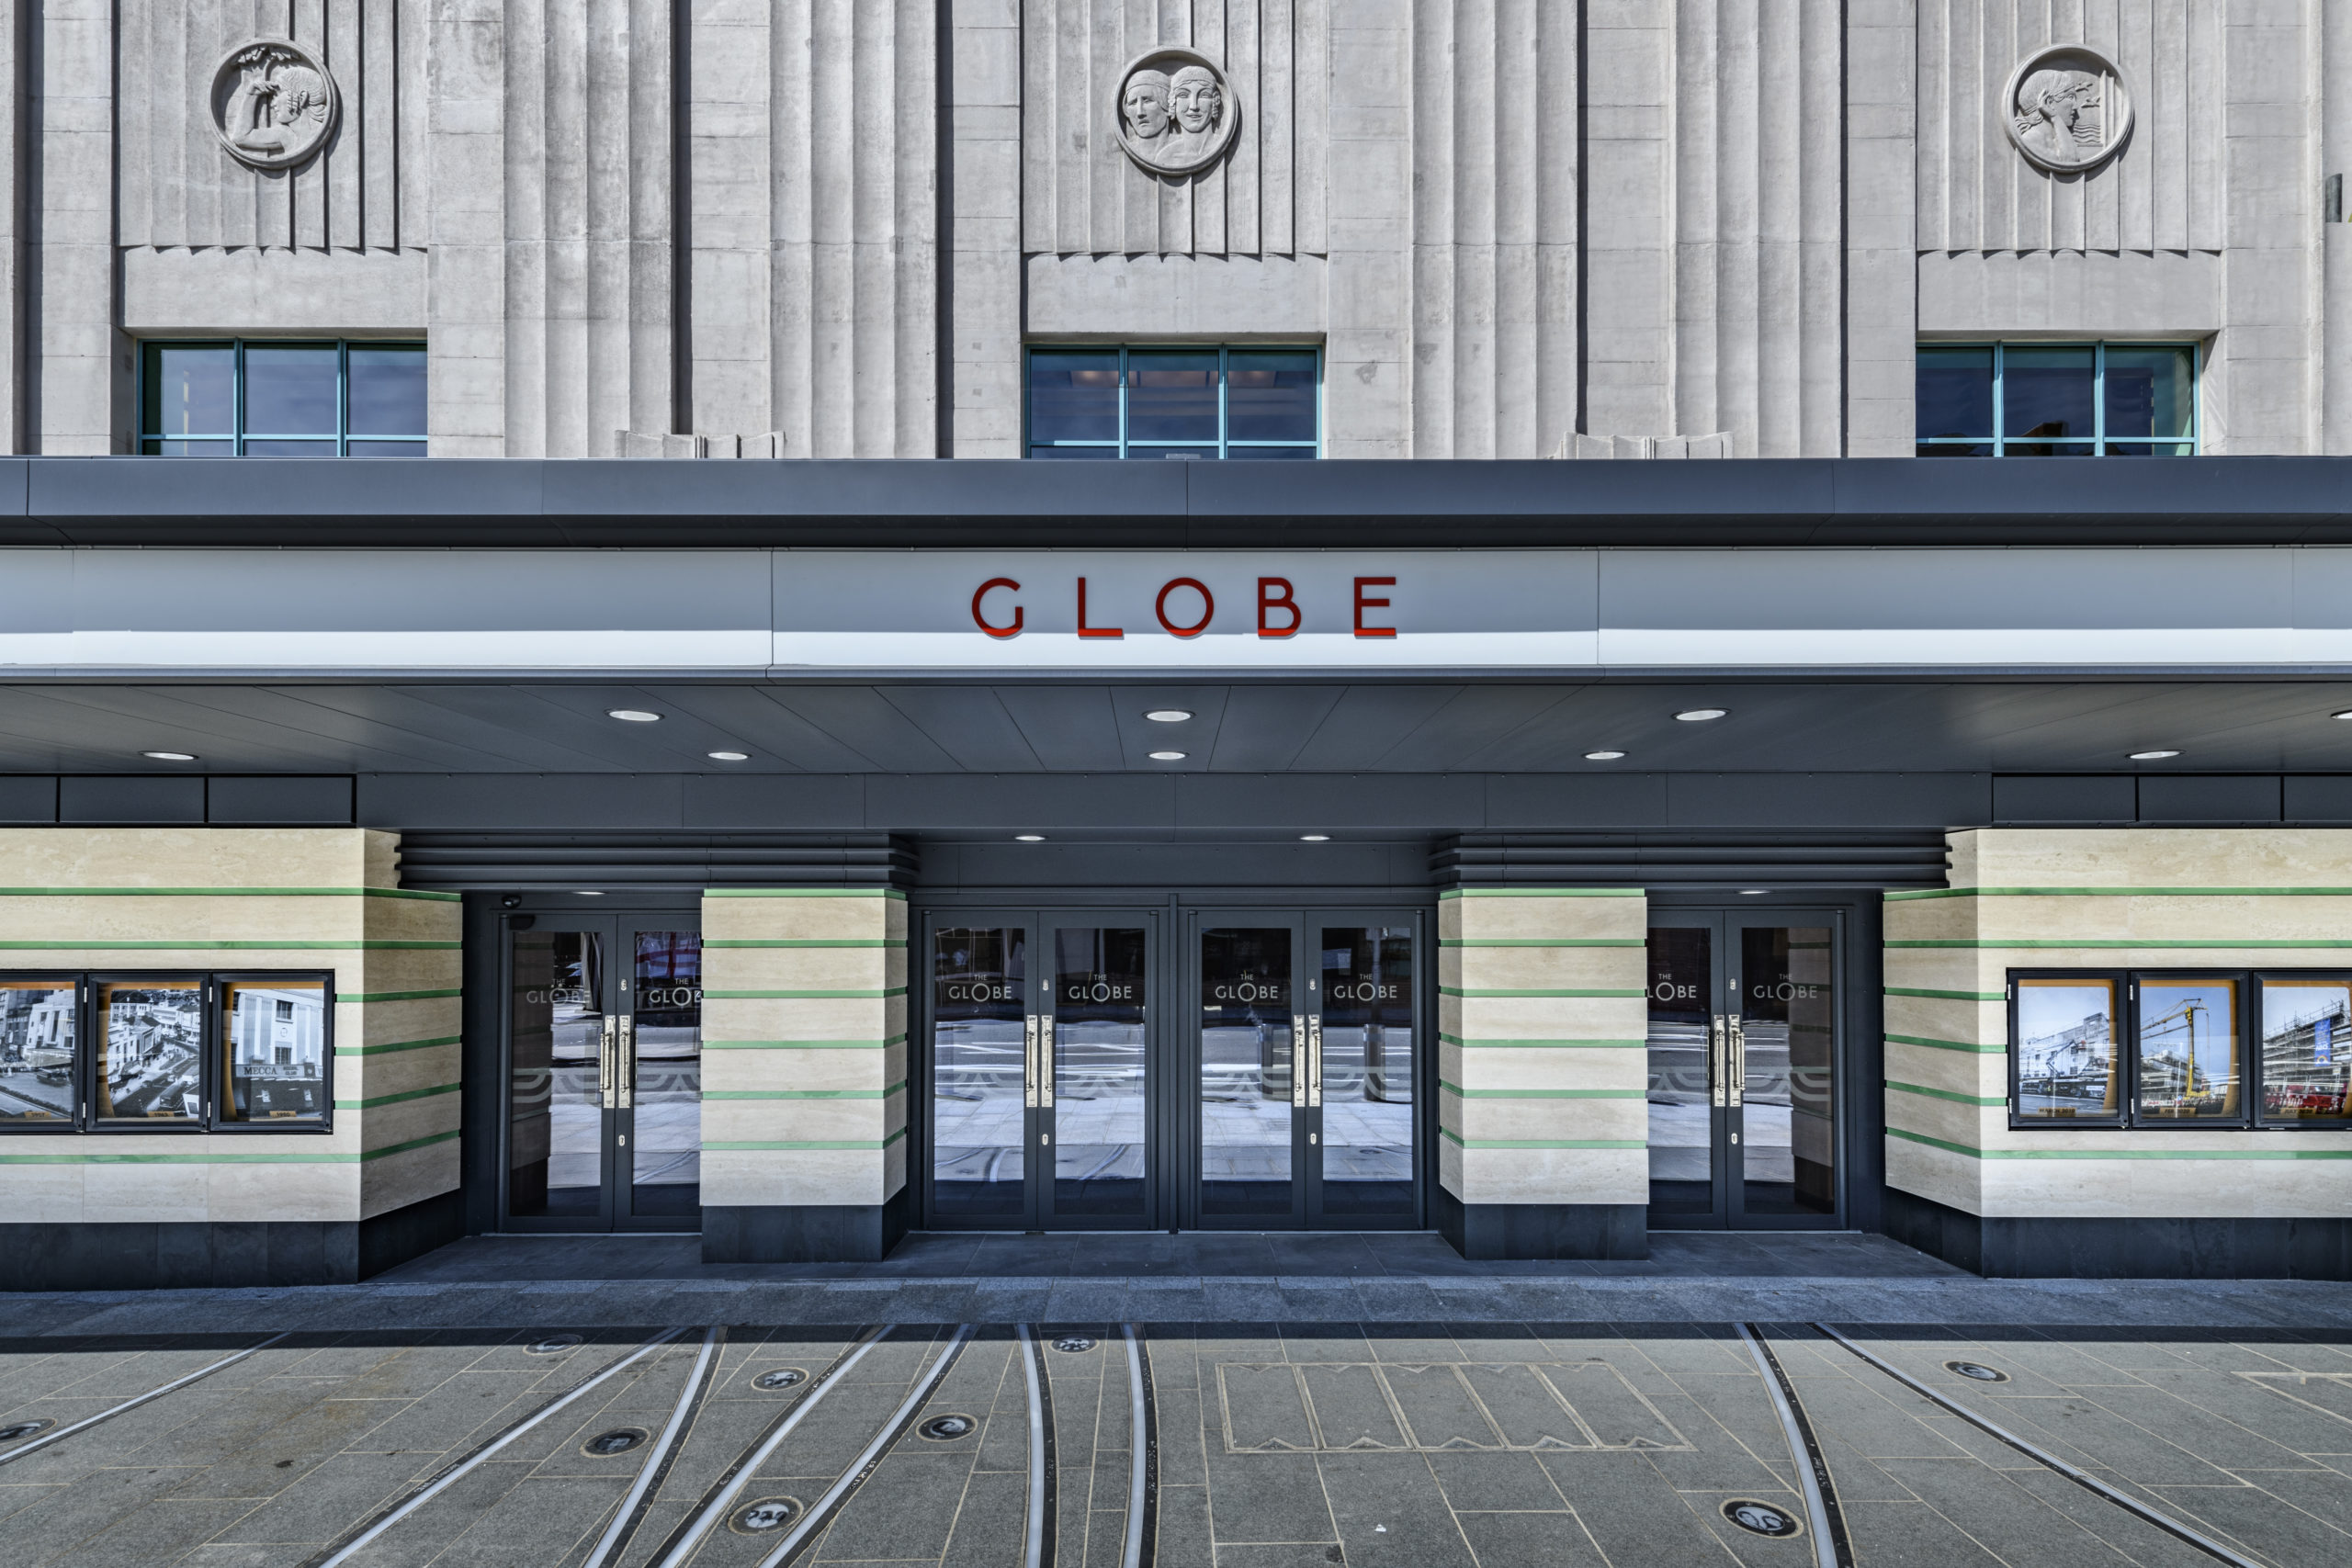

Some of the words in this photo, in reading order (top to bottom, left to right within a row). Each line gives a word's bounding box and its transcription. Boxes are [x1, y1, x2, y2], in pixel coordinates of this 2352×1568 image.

[971, 577, 1396, 637] GLOBE
[526, 987, 591, 1006] GLOBE
[650, 987, 702, 1007] GLOB
[949, 983, 1012, 1002] GLOBE
[1069, 983, 1132, 1002] GLOBE
[1216, 982, 1279, 1002] GLOBE
[1334, 982, 1397, 1001] GLOBE
[1647, 982, 1697, 1001] LOBE
[1753, 982, 1817, 1001] GLOBE
[243, 1066, 277, 1076] MECCA
